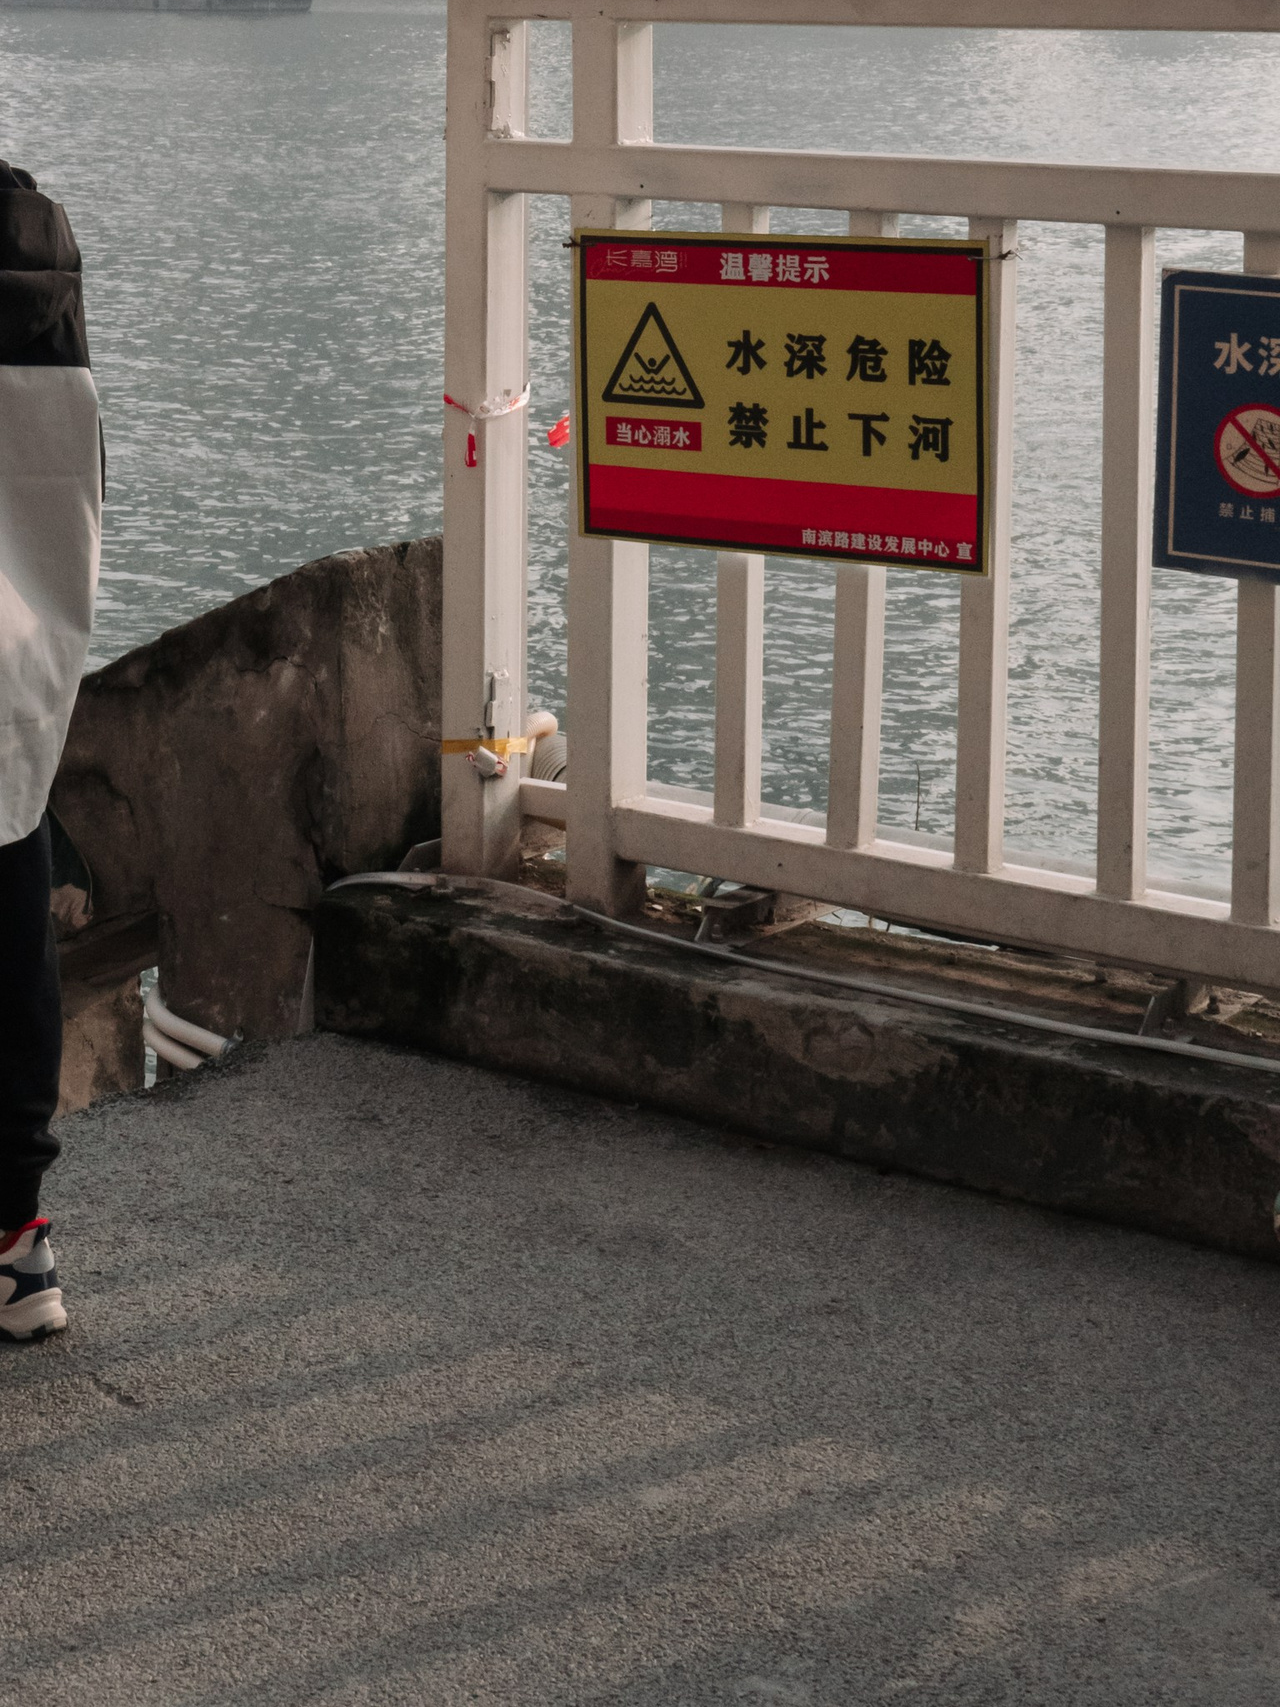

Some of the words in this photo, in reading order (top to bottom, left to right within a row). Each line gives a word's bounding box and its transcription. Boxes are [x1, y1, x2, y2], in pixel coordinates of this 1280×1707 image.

[720, 252, 830, 284] 温馨提示
[726, 329, 952, 386] 水深危险
[616, 422, 691, 447] 当心溺水
[727, 402, 954, 462] 禁止下河
[801, 527, 950, 558] 南滨路建设发展中心
